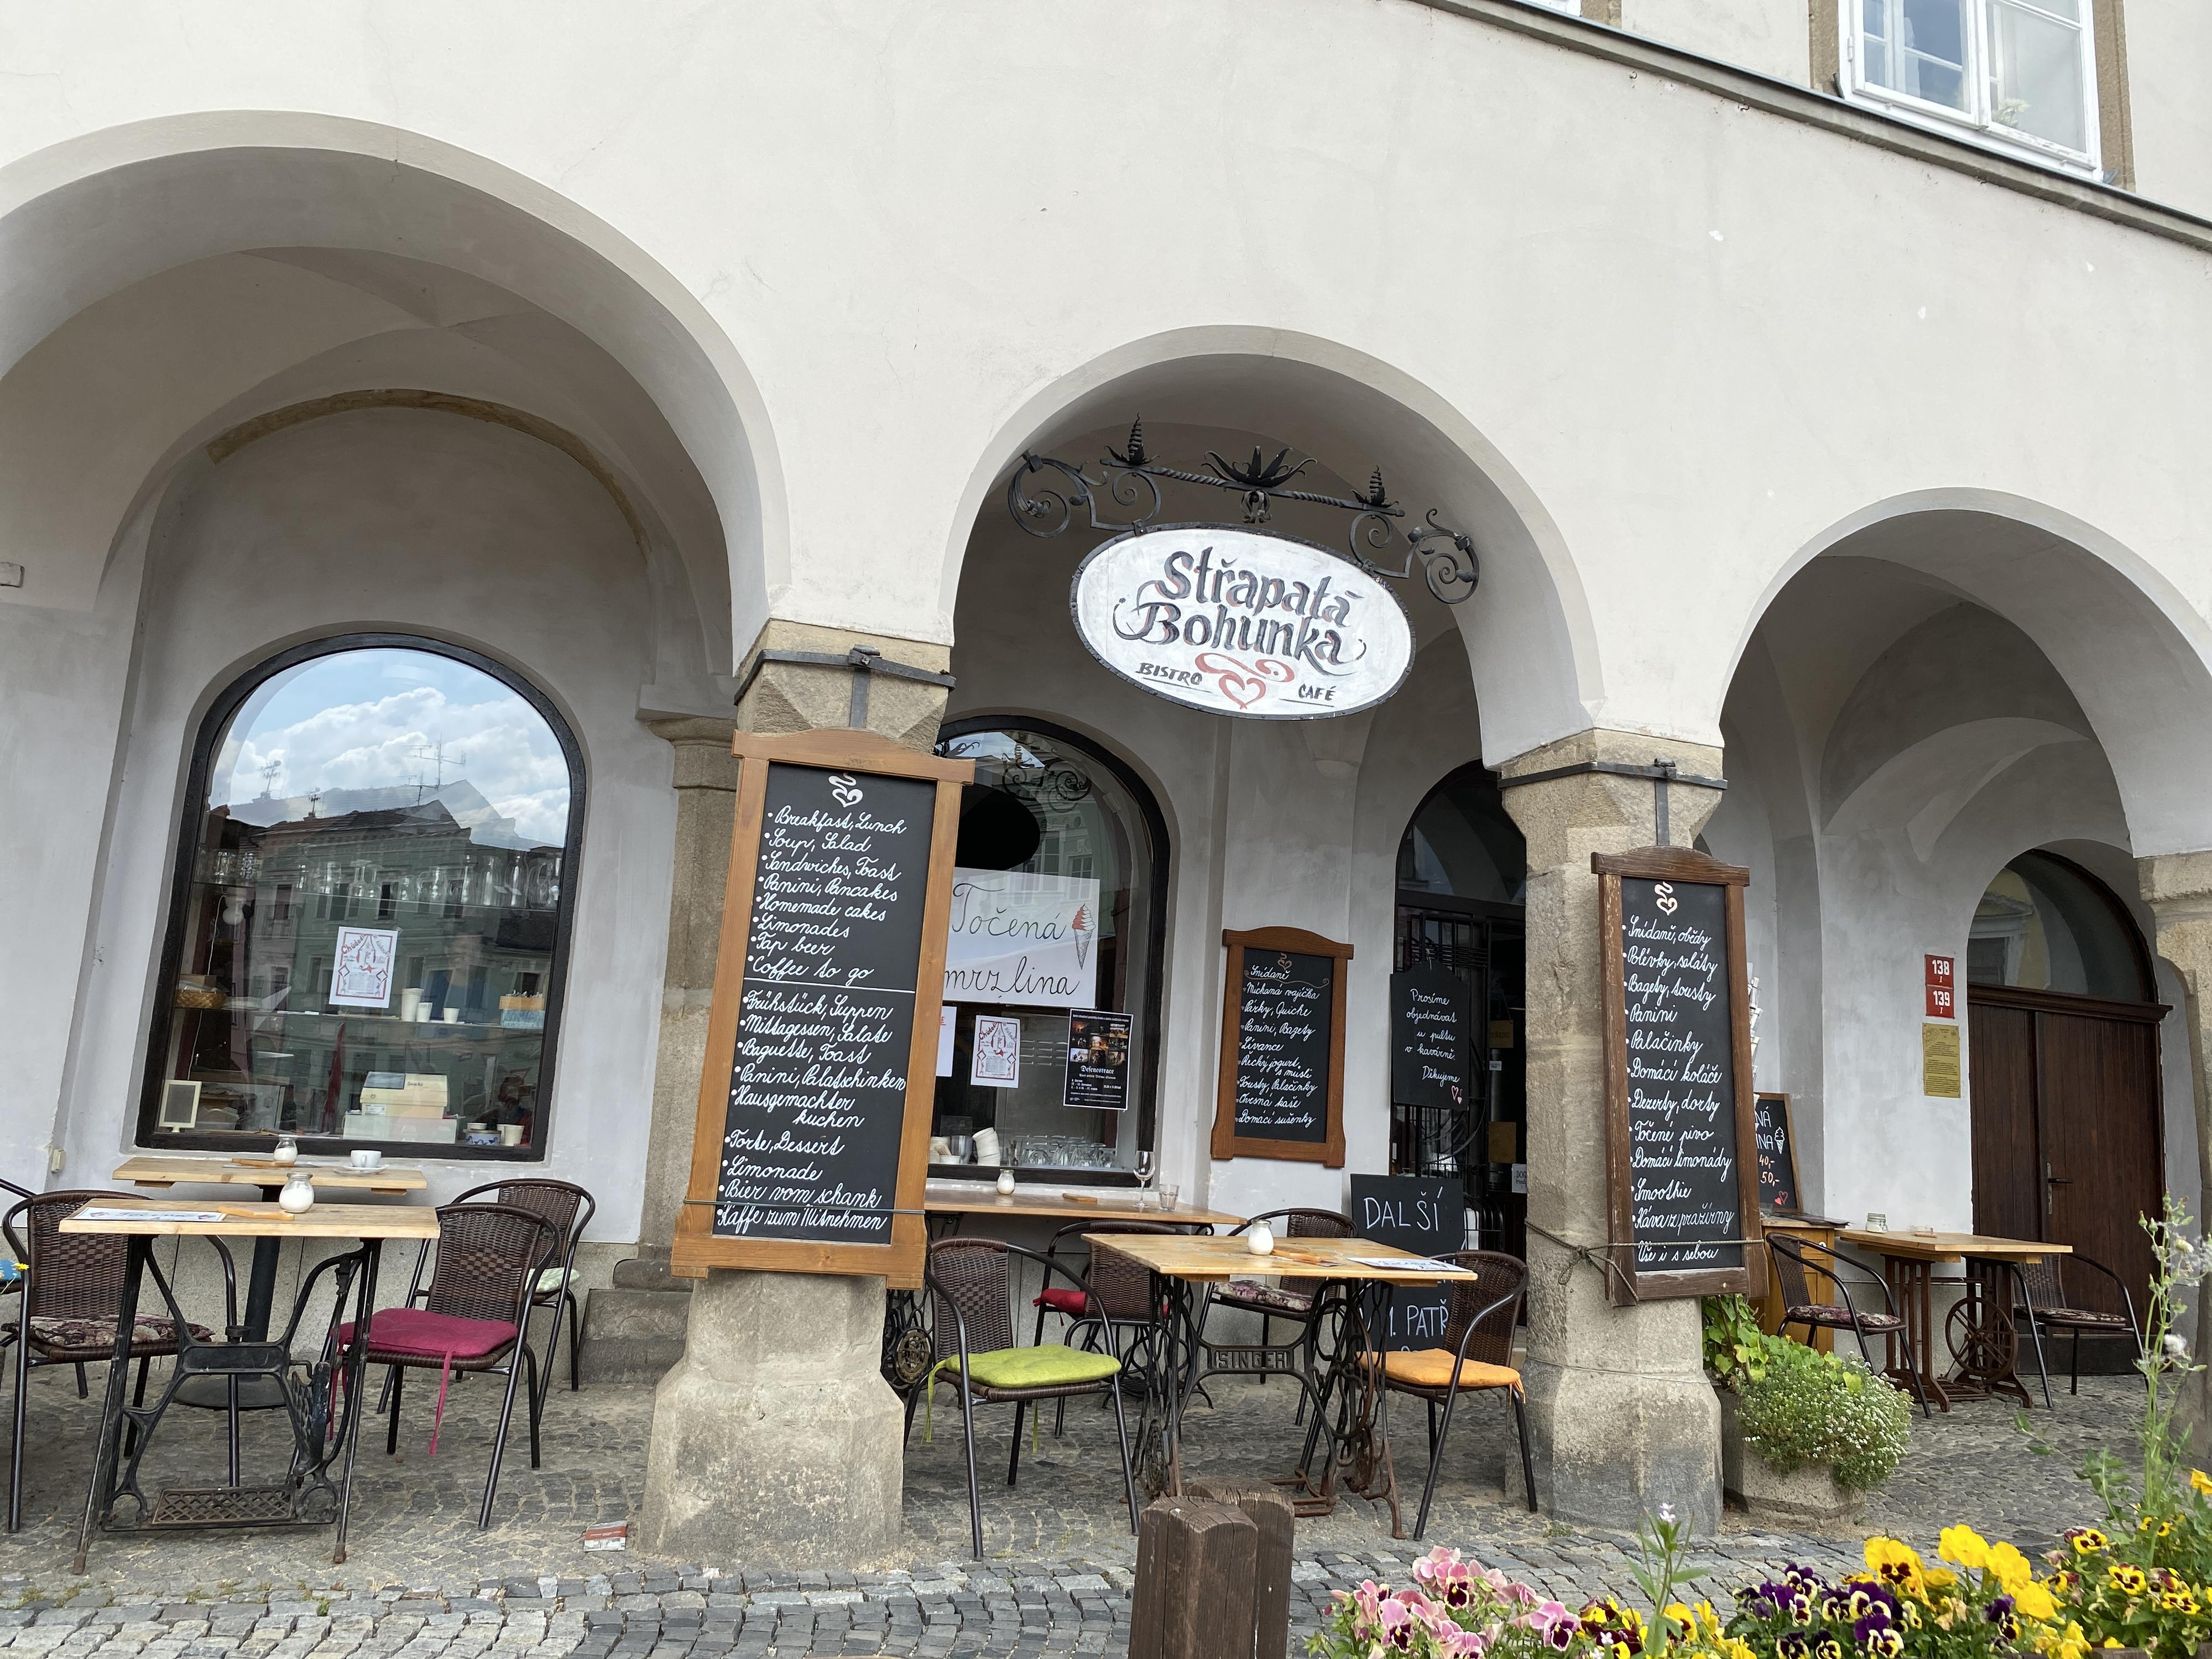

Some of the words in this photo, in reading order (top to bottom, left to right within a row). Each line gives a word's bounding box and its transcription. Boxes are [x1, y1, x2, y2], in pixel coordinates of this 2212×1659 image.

[1137, 546, 1364, 628] Střapatá
[1113, 603, 1366, 675] Bohunka
[1135, 662, 1202, 685] BISTRO
[1298, 685, 1337, 701] CAFÉ
[855, 811, 907, 834] Lunch
[769, 828, 815, 857] Soup,
[822, 832, 872, 852] Salad
[765, 851, 852, 880] Sandwiches,
[855, 856, 902, 881] Toast
[763, 873, 822, 897] Panini,
[825, 877, 898, 901] Pancakes
[759, 892, 841, 916] Homemade
[844, 902, 886, 922] cakes
[952, 883, 1067, 940] Točená
[757, 912, 851, 938] Limonades
[756, 931, 788, 957] Tap
[791, 938, 836, 956] beer
[1677, 926, 1712, 951] obědy
[752, 956, 810, 980] Coffee
[813, 957, 842, 978] to
[846, 967, 875, 987] go
[945, 956, 1080, 996] mrzlina
[1250, 964, 1291, 980] Snídaně
[1676, 952, 1718, 982] saláty
[1932, 959, 1950, 975] 138
[1246, 982, 1283, 995] Míchaná
[1284, 987, 1320, 1002] vajíčka
[1410, 988, 1450, 1005] Prosíme
[1671, 977, 1716, 1011] tousty
[1933, 990, 1950, 1006] 139
[830, 994, 894, 1025] Suppen
[1276, 1001, 1312, 1019] Quiche
[1406, 1007, 1457, 1024] objednávat
[1630, 1003, 1678, 1023] Panini
[744, 1013, 834, 1042] Mittagessen,
[837, 1022, 894, 1044] Salate
[1279, 1022, 1317, 1042] Bagety
[1430, 1030, 1456, 1042] pultu
[742, 1037, 813, 1064] Baguette,
[820, 1042, 872, 1065] Toast
[1241, 1036, 1284, 1051] Lívance
[1630, 1029, 1704, 1062] Palačinky
[1241, 1050, 1270, 1073] Řecký
[1630, 1057, 1679, 1082] Domácí
[1680, 1061, 1723, 1084] koláče
[740, 1062, 800, 1089] Panini,
[802, 1063, 906, 1092] Palatschinken
[1422, 1065, 1460, 1087] Děkujeme
[734, 1084, 856, 1113] Hausgemachter
[1239, 1092, 1273, 1107] Ovesná
[1274, 1095, 1301, 1108] kaše
[1681, 1089, 1720, 1122] dorty
[792, 1109, 865, 1128] kuchen
[1238, 1109, 1275, 1124] Domácí
[1274, 1112, 1317, 1128] sušenky
[729, 1129, 774, 1154] Torte,
[774, 1130, 845, 1155] Dessert
[1634, 1119, 1674, 1142] Točené
[1679, 1125, 1715, 1149] pivo
[727, 1155, 823, 1181] Limonade
[1632, 1145, 1673, 1168] Domácí
[1673, 1147, 1733, 1183] limonády
[1759, 1154, 1775, 1170] 40,-
[724, 1178, 768, 1199] Bier
[769, 1186, 816, 1203] vom
[1634, 1177, 1692, 1202] Smoothie
[1760, 1171, 1780, 1187] 50,-
[764, 1209, 801, 1226] zum
[800, 1204, 888, 1230] Mitnehmen
[1363, 1186, 1443, 1232] DALŠÍ
[1634, 1204, 1668, 1229] Káva
[1658, 1245, 1668, 1261] i
[1671, 1250, 1679, 1261] s
[1682, 1239, 1719, 1261] sebou
[1219, 1351, 1285, 1369] SINGER
